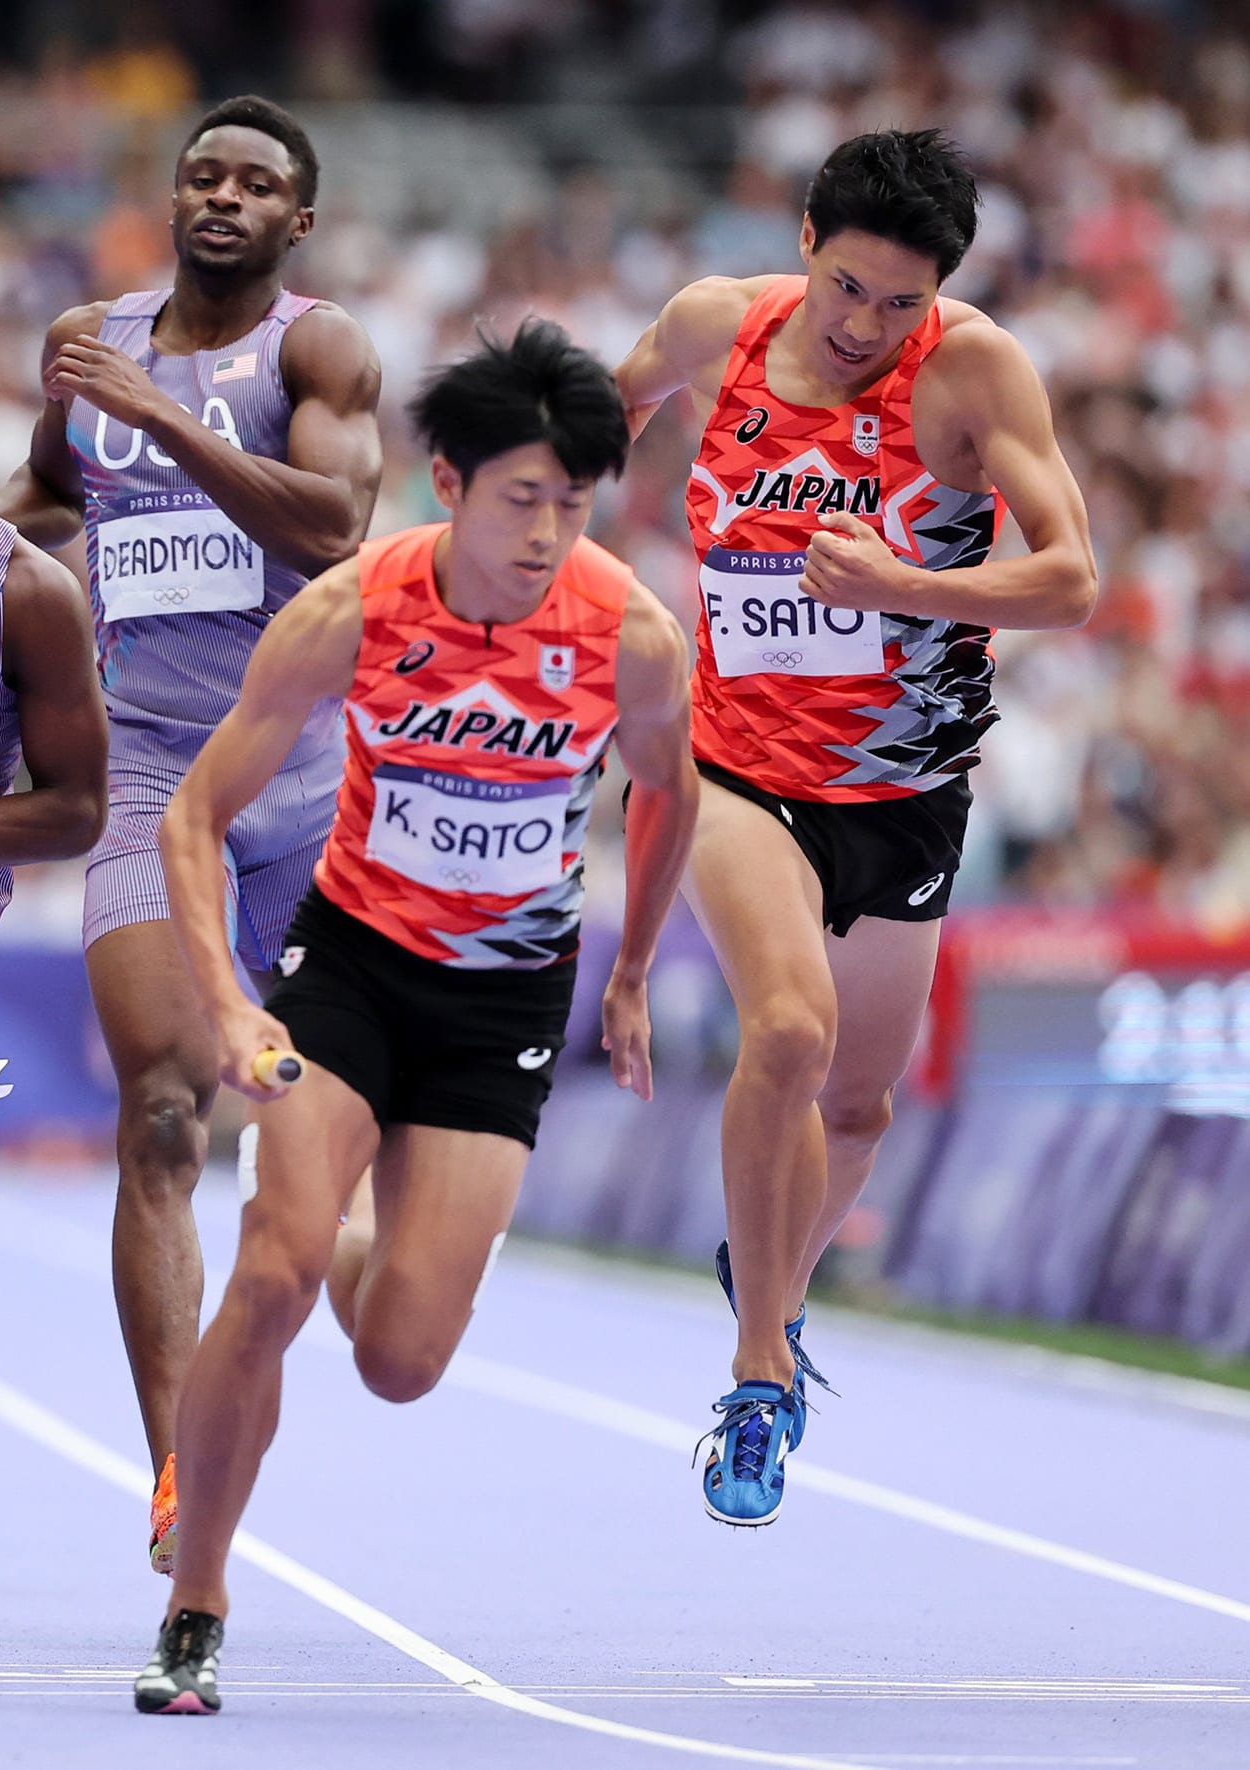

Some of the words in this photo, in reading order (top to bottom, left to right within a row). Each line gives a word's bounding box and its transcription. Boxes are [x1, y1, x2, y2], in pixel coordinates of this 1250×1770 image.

[130, 495, 168, 511] PARIS
[735, 468, 881, 515] JAPAN
[103, 532, 253, 581] DEADMON
[730, 556, 777, 569] PARIS
[783, 557, 806, 569] 20
[706, 592, 729, 635] F.
[741, 597, 864, 637] SATO
[379, 703, 575, 758] JAPAN
[423, 772, 472, 796] PARIS
[478, 784, 523, 799] 2024
[385, 790, 418, 839] K.
[431, 816, 553, 859] SATO
